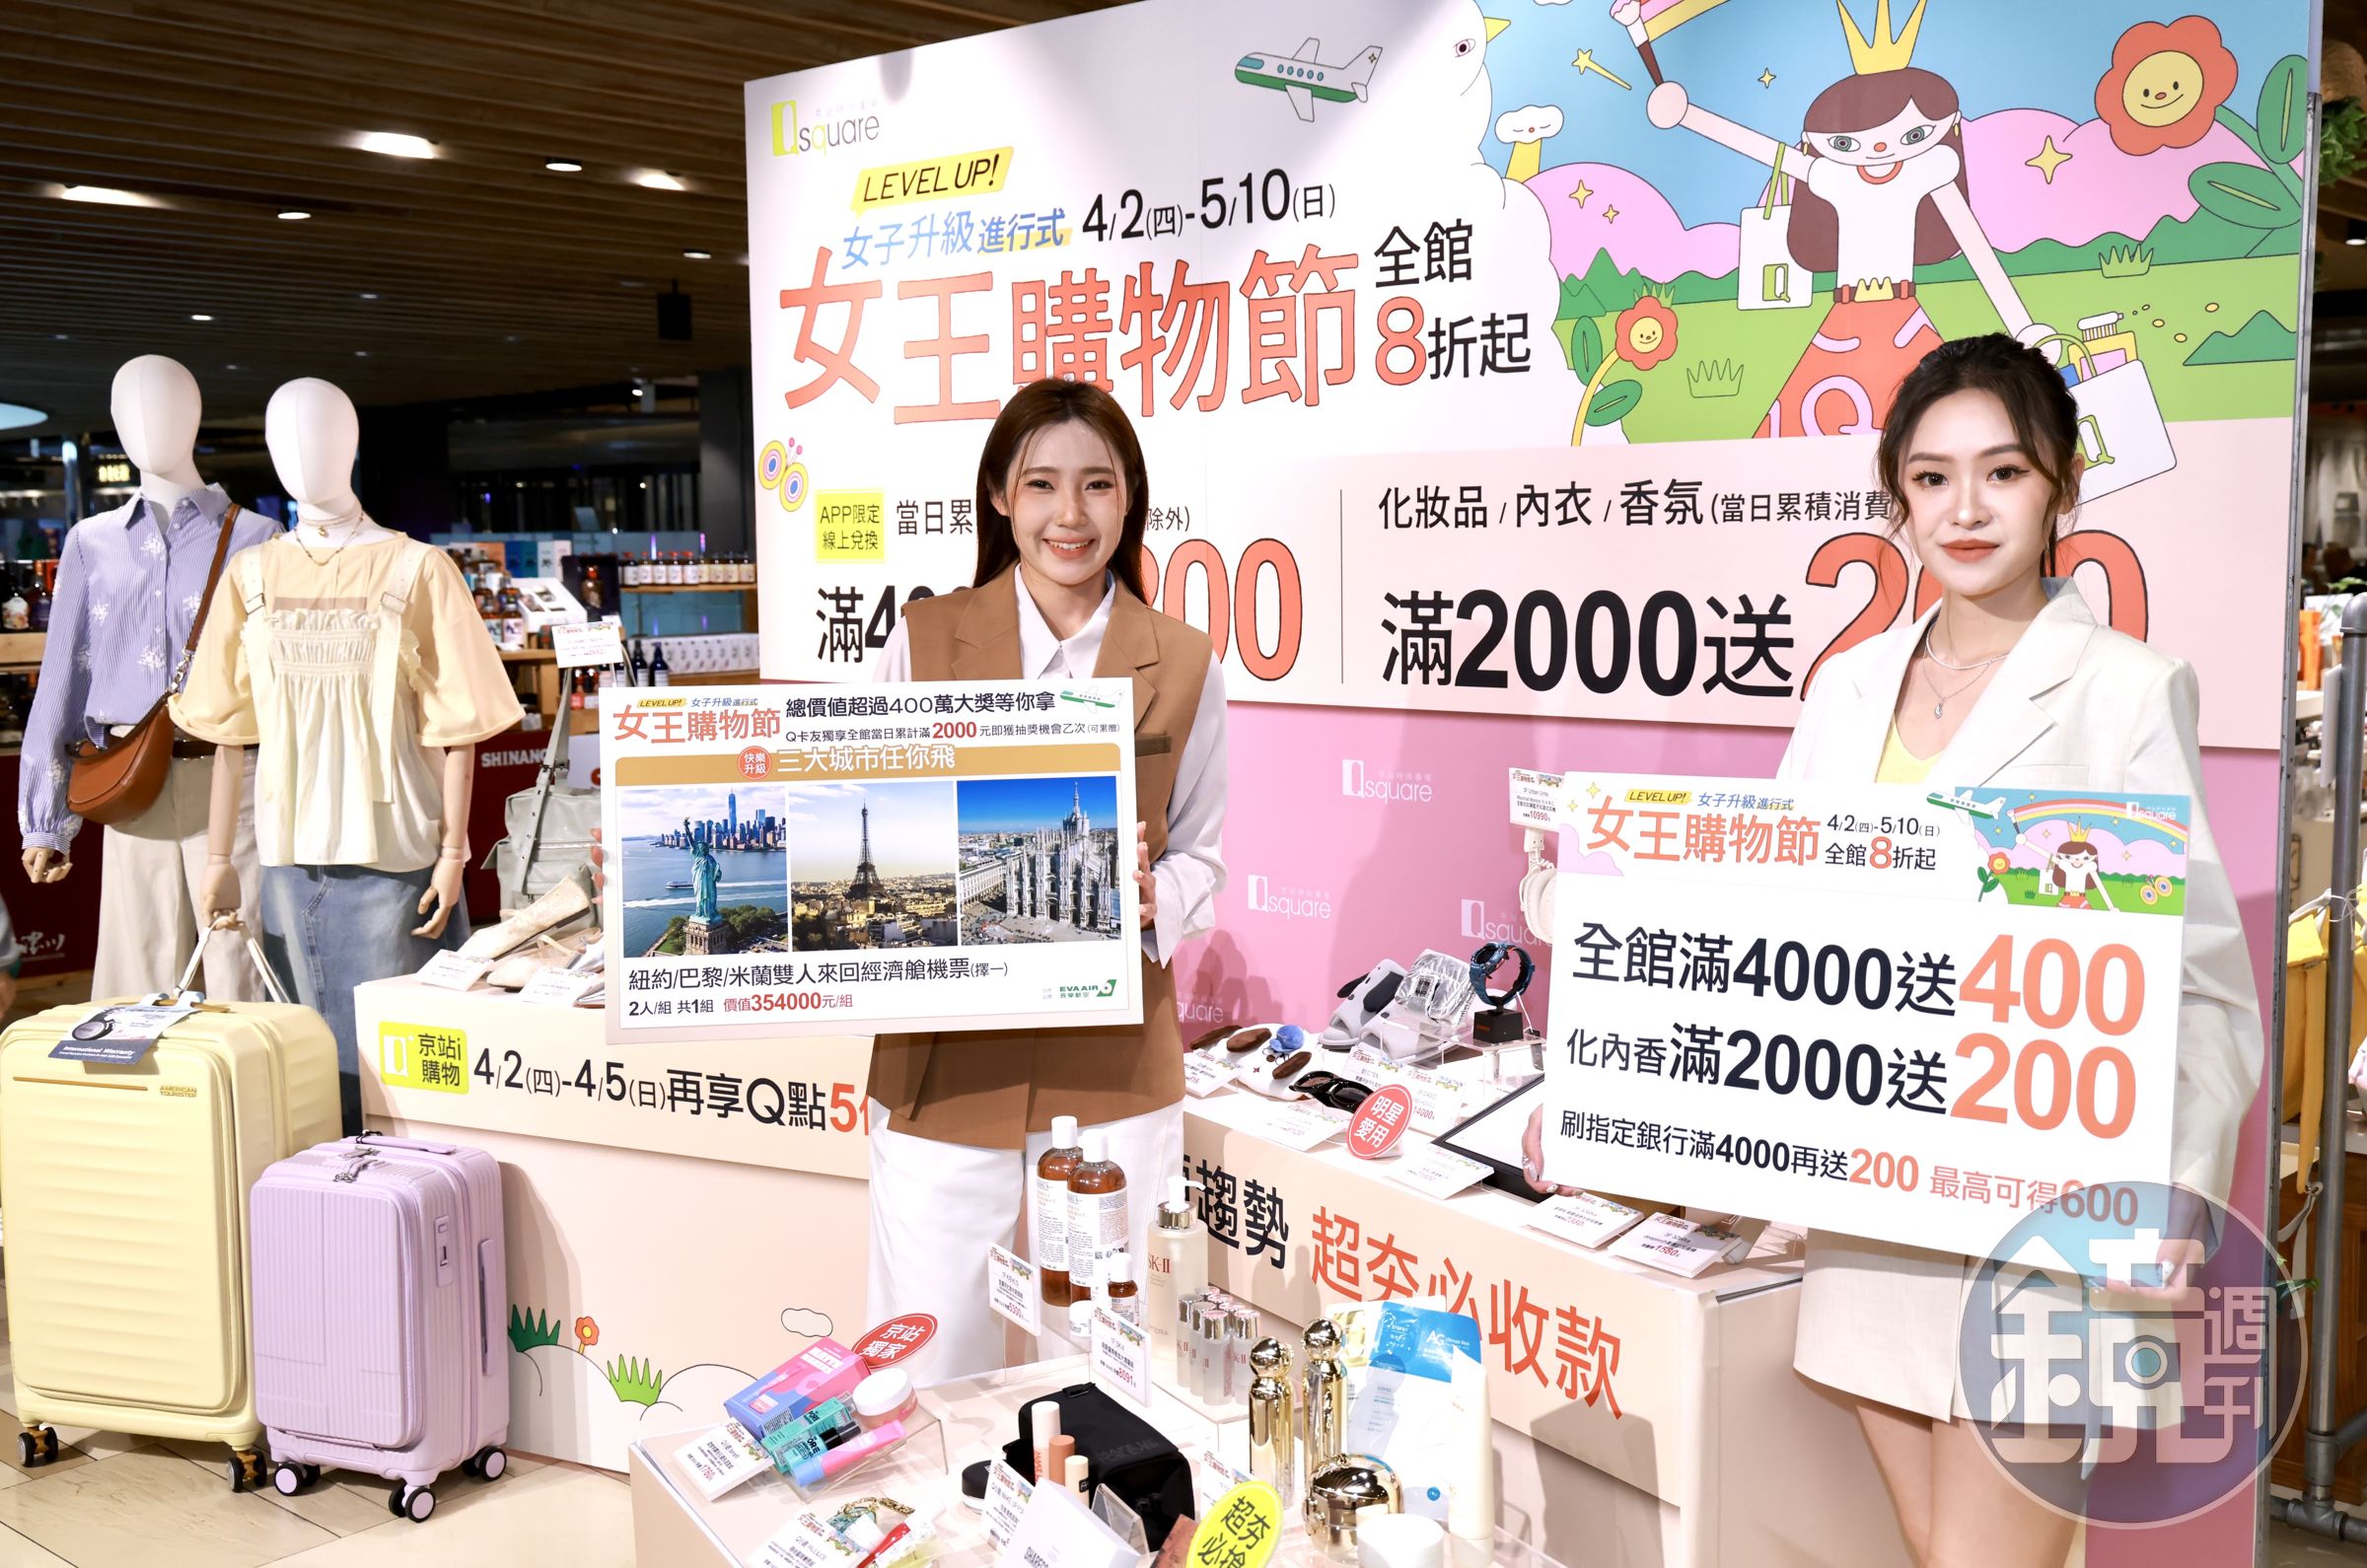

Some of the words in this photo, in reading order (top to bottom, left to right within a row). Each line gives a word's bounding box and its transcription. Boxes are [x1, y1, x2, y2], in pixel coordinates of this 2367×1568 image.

[862, 167, 952, 202] LEVEL
[954, 154, 1000, 188] UP!
[841, 208, 1066, 270] 女子升級進行式
[1373, 218, 1473, 288] 全館
[779, 243, 1359, 425] 女王購物節
[1375, 296, 1532, 386] 8折起
[819, 503, 881, 526] APP限定
[896, 498, 973, 535] 當日累
[822, 529, 880, 552] 線上兌換
[639, 698, 667, 708] LEVEL
[785, 691, 1056, 719] 總價值超過400萬大獎等你拿
[612, 704, 781, 745] 女王購物節
[744, 752, 765, 764] 快樂
[745, 763, 766, 774] 升級
[776, 743, 956, 773] 三大城市任你飛
[1629, 791, 1666, 802] LEVEL
[1667, 793, 1687, 803] UP!
[1697, 792, 1795, 812] 女子升級進行式
[1586, 795, 1821, 867] 女王購物節
[1825, 835, 1937, 872] 全館8折起
[628, 1000, 673, 1018] 2人/組
[678, 997, 715, 1016] 共1組
[723, 990, 854, 1013] 價值354000元/組
[421, 1058, 462, 1087] 購物
[1370, 1095, 1404, 1127] 明星
[1354, 1119, 1390, 1149] 愛用
[880, 1322, 926, 1343] 京站
[859, 1339, 906, 1361] 獨家
[1220, 1495, 1271, 1550] 超夯
